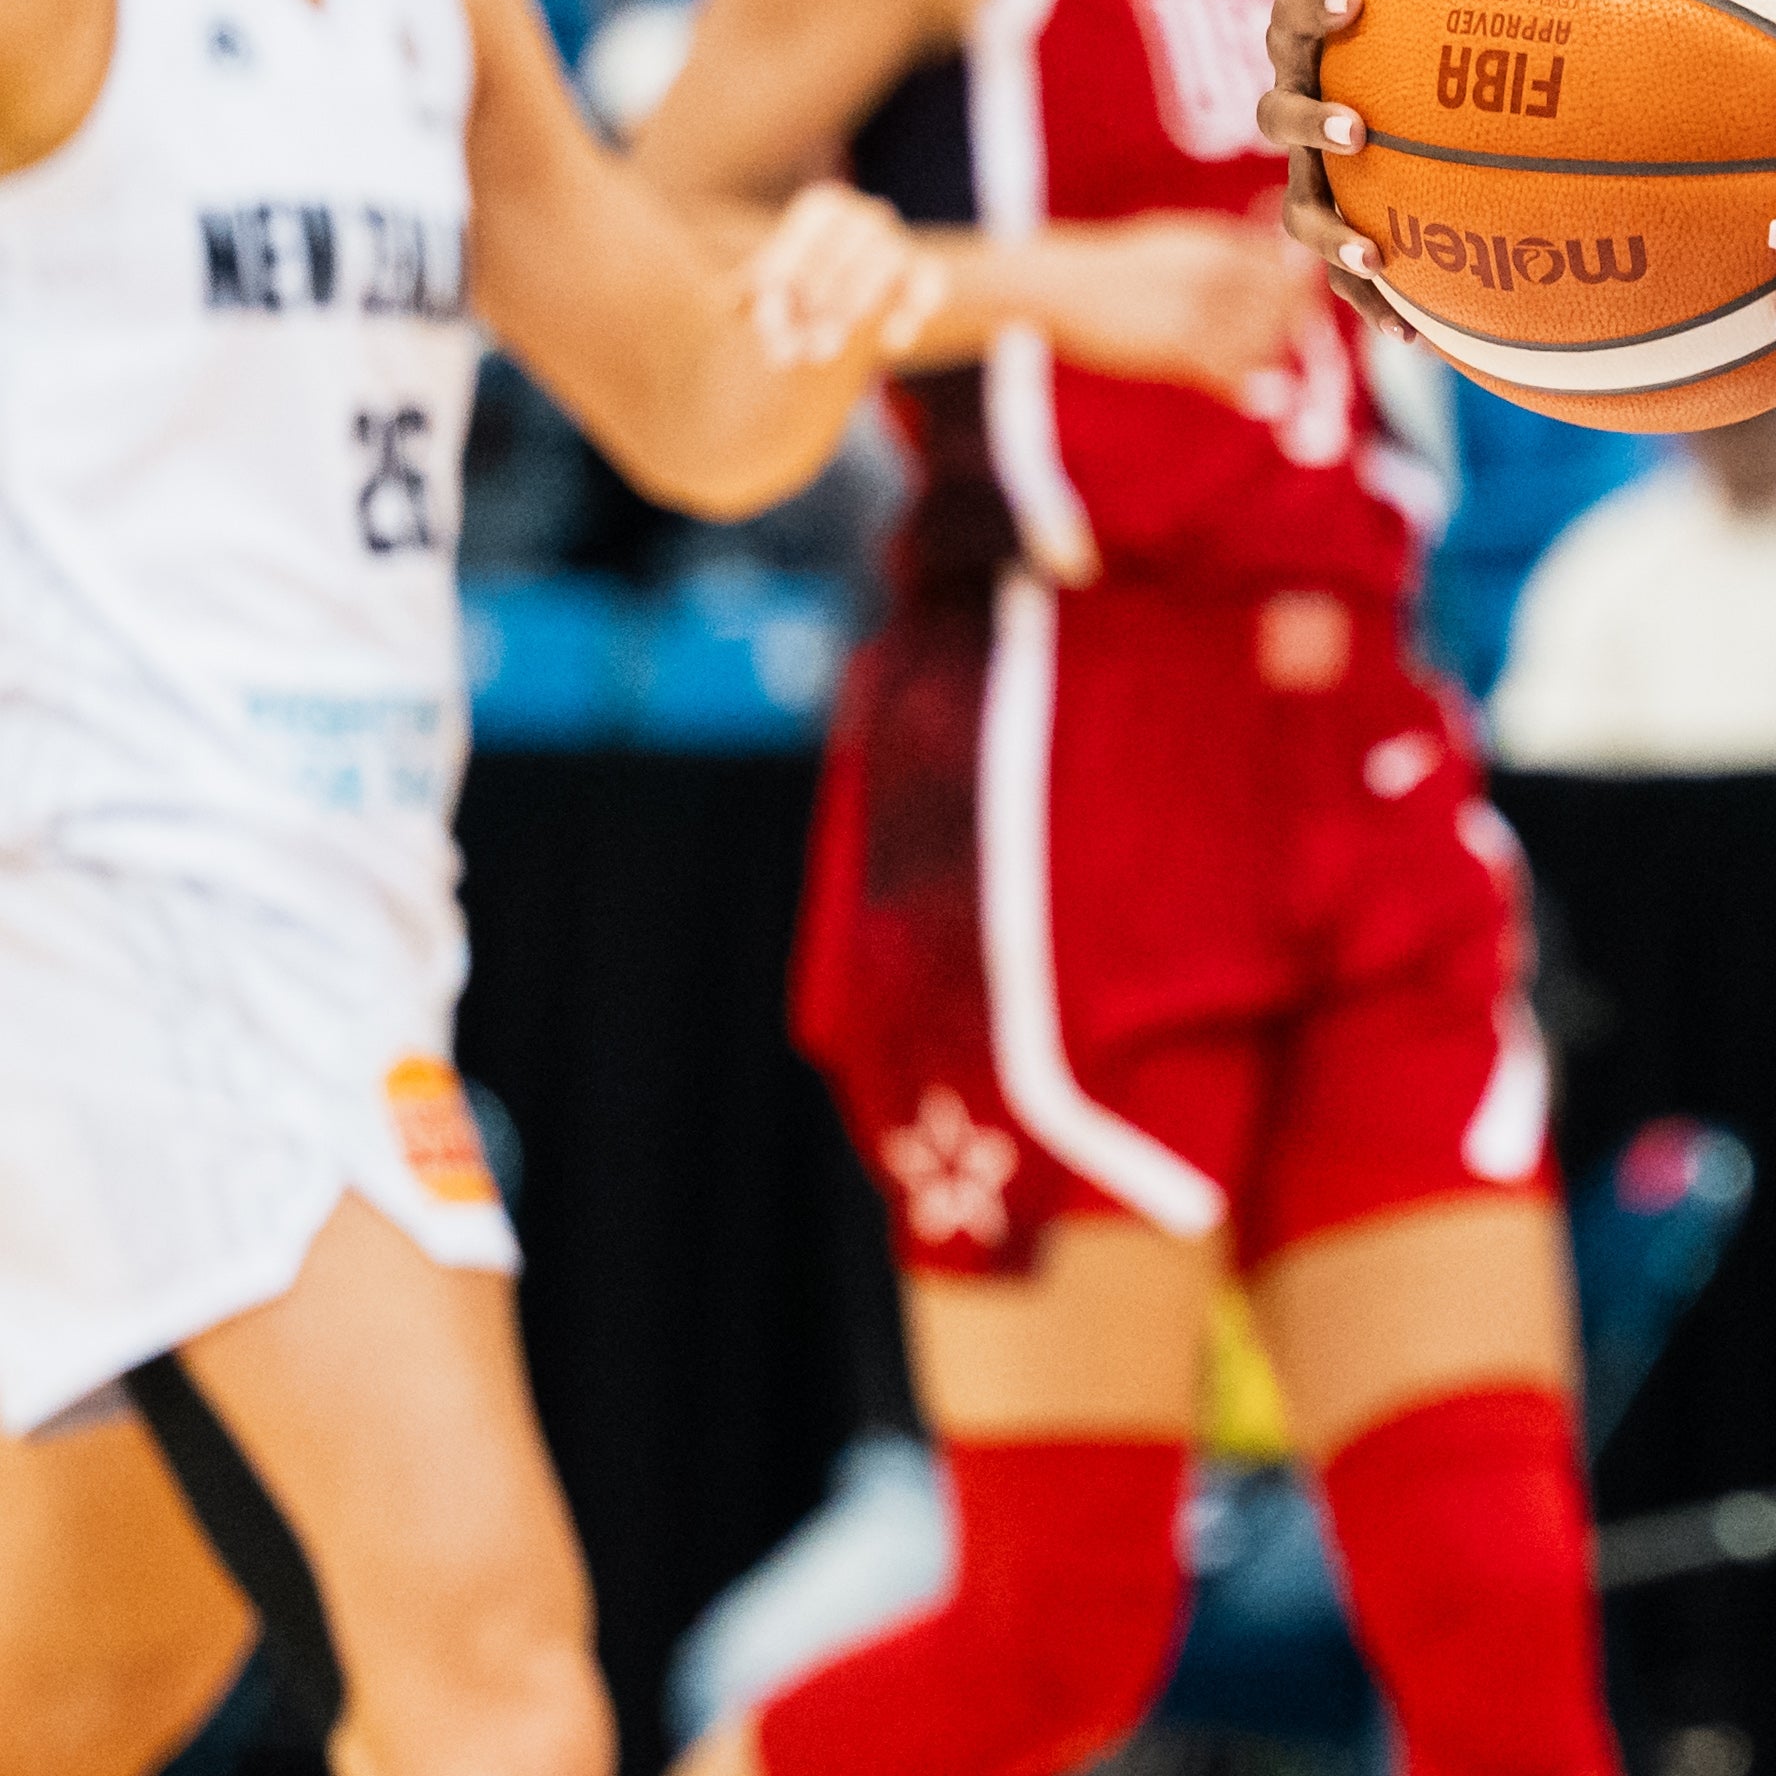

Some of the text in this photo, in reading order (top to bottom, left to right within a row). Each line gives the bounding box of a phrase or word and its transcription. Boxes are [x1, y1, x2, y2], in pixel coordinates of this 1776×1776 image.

[1446, 9, 1572, 46] APPROVED
[1436, 44, 1565, 119] FIBA
[198, 202, 336, 312] NEW
[1387, 206, 1648, 292] molten
